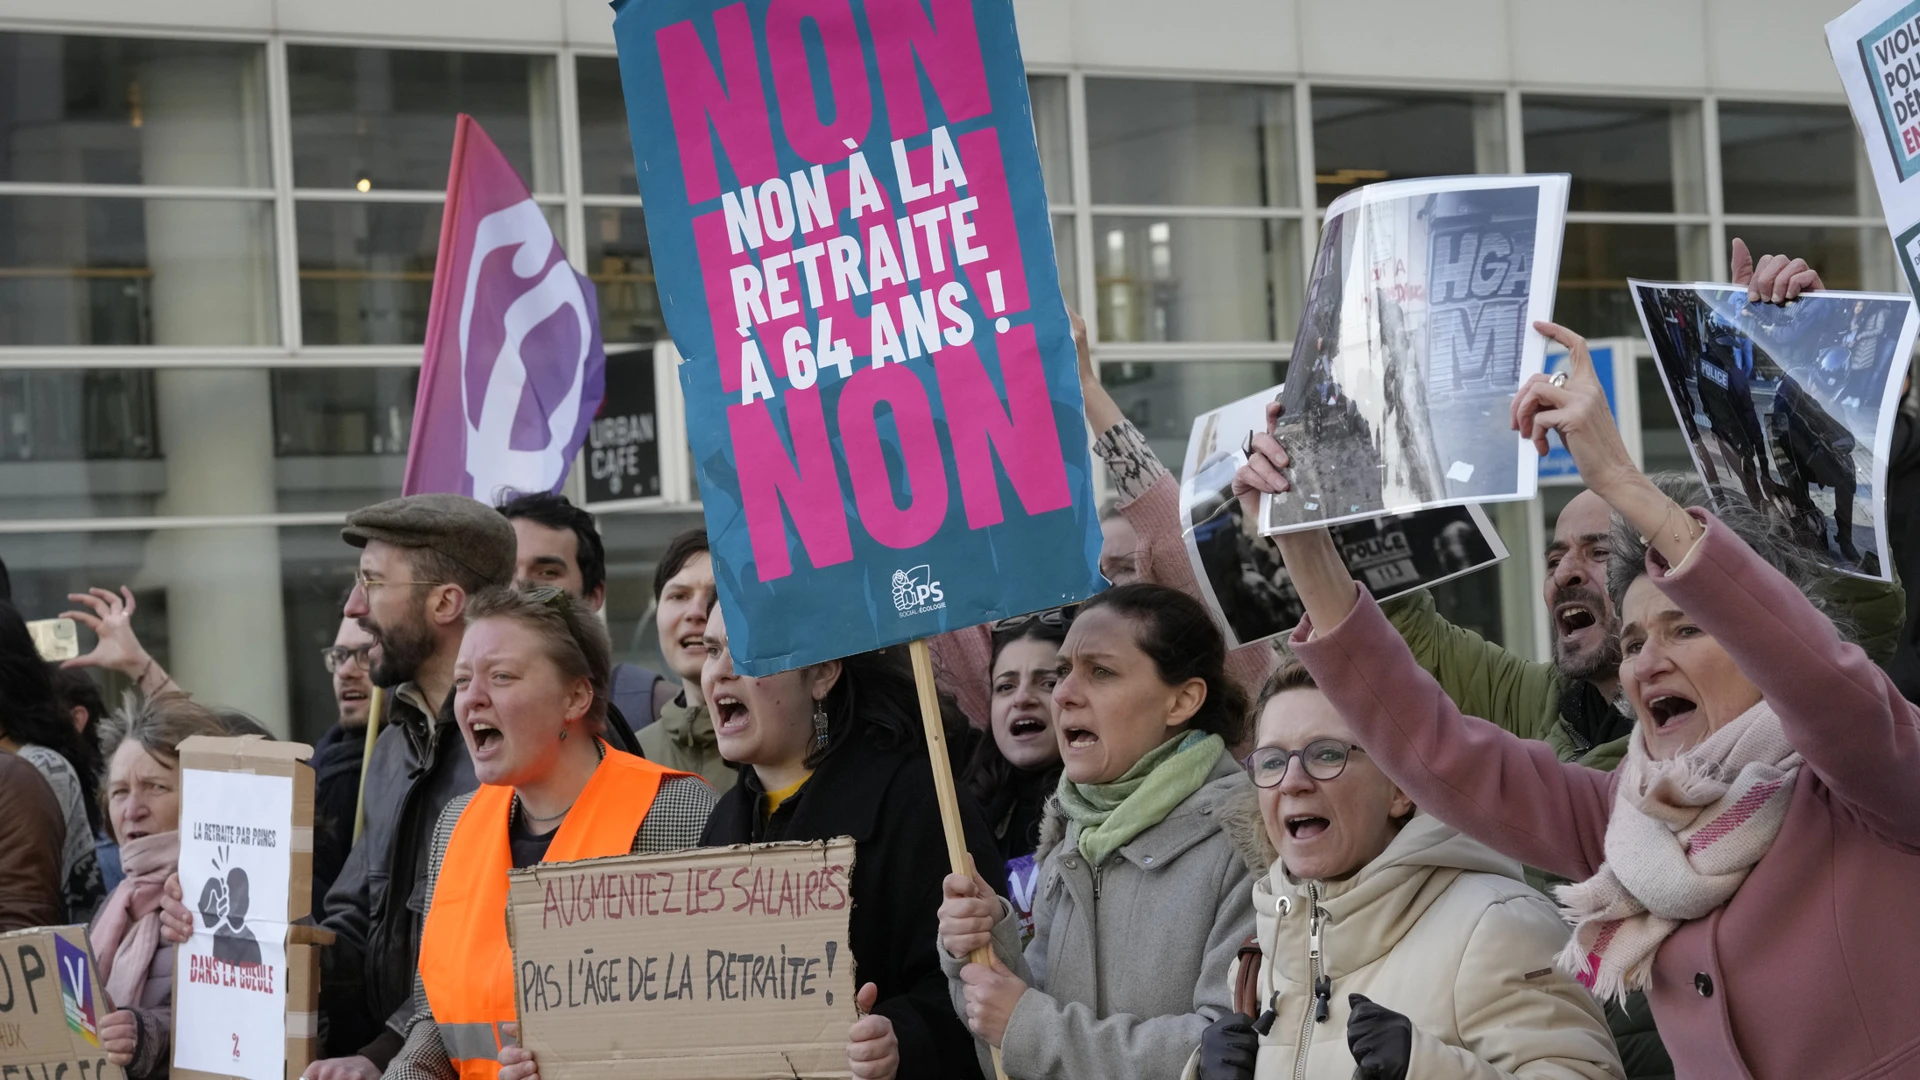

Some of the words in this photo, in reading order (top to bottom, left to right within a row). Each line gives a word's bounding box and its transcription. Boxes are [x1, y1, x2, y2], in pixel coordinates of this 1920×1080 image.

[655, 0, 993, 206] NON
[722, 164, 834, 255] NON
[842, 137, 885, 219] À
[891, 125, 968, 204] LA
[729, 195, 989, 330] RETRAITE
[735, 326, 775, 406] À
[782, 317, 853, 390] 64
[872, 281, 974, 370] ANS
[1701, 361, 1727, 386] POLICE
[590, 413, 654, 449] URBAN
[727, 323, 1073, 583] NON
[1345, 533, 1406, 562] POLICE
[916, 581, 944, 605] PS
[194, 822, 202, 840] LA
[204, 823, 234, 844] RETRAITE
[236, 826, 251, 845] PAR
[543, 872, 682, 930] AUGMENTEZ
[686, 867, 725, 916] LES
[732, 864, 846, 919] SALAIRES
[190, 954, 219, 985] DANS
[222, 957, 237, 988] LA
[239, 961, 273, 994] GUEULE
[521, 960, 562, 1013] PAS
[628, 956, 658, 1001] DE
[664, 952, 693, 1001] LA
